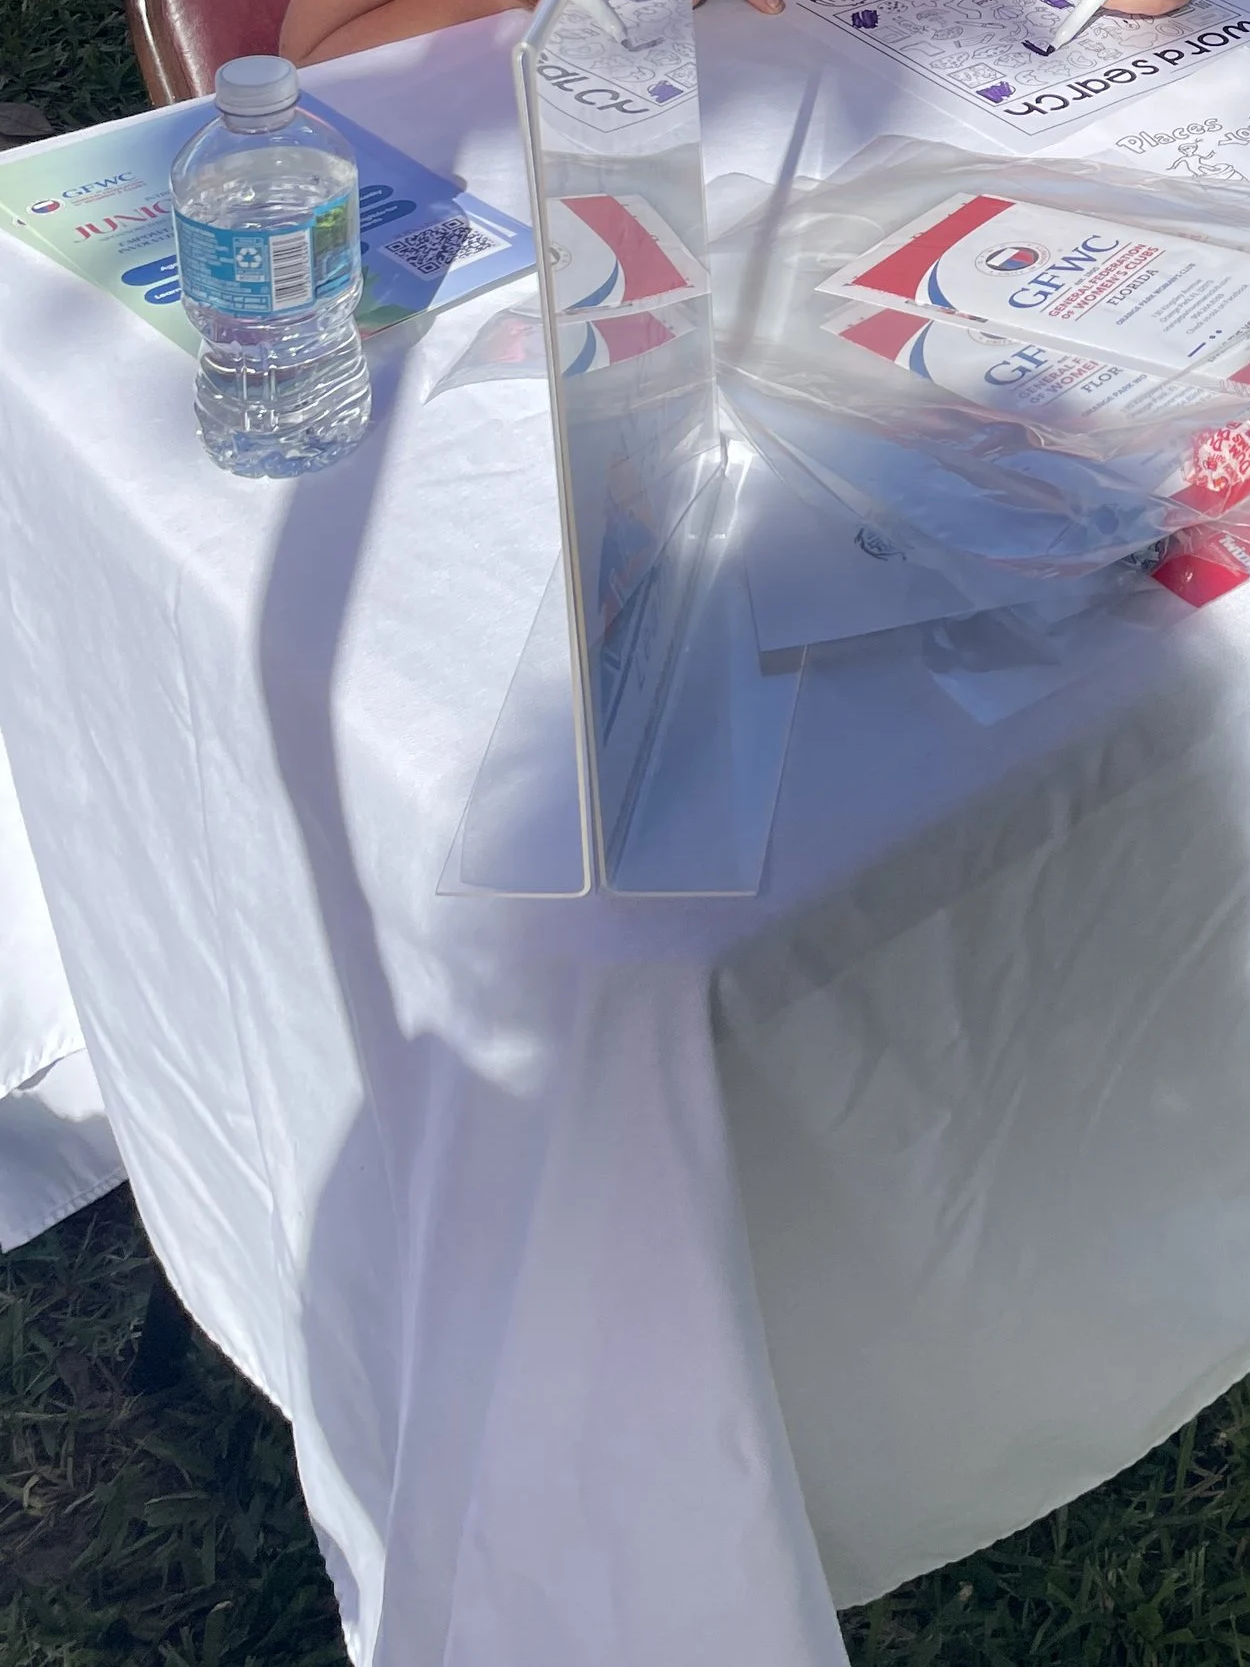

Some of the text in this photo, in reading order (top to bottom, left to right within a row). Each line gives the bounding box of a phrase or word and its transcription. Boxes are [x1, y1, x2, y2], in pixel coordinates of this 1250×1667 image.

[1003, 58, 1160, 117] search
[1115, 117, 1223, 154] Places
[61, 171, 137, 199] GFWC
[1008, 234, 1120, 309] GFWC
[1048, 243, 1147, 317] GENERAL FEDERATION
[1061, 246, 1159, 320] OF WOMEN'S CLUBS
[1106, 269, 1160, 306] FLORIDA
[1179, 262, 1196, 276] CLUB
[983, 344, 1049, 386] GF
[1018, 364, 1074, 400] GENERAL
[1030, 360, 1100, 404] OF WOME
[1080, 366, 1124, 394] FLOR
[1112, 382, 1135, 398] PARK
